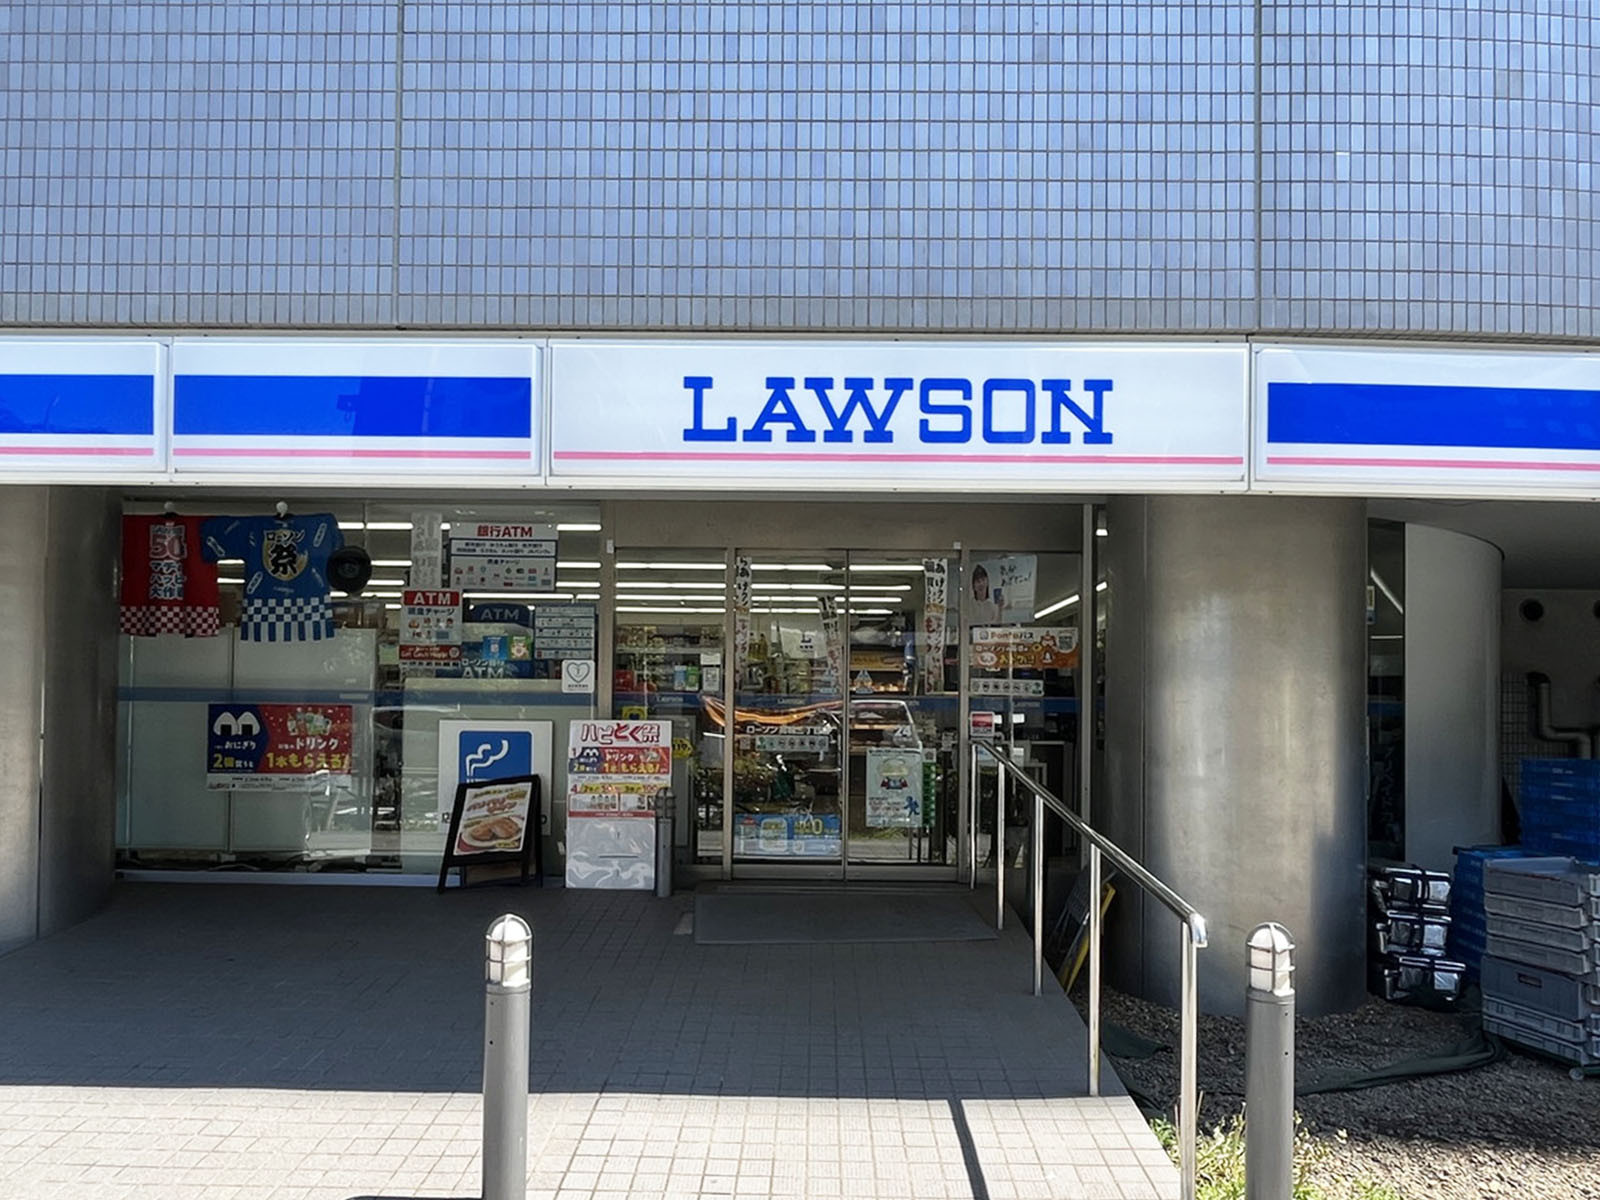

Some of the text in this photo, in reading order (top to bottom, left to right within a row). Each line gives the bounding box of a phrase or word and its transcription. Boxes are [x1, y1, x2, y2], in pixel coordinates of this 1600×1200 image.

[683, 376, 1113, 445] LAWSON
[476, 524, 533, 538] 銀行ATM
[269, 543, 298, 575] 祭
[413, 592, 451, 605] ATM
[480, 608, 520, 621] ATM
[462, 666, 505, 679] ATM
[296, 737, 339, 750] ドリンク
